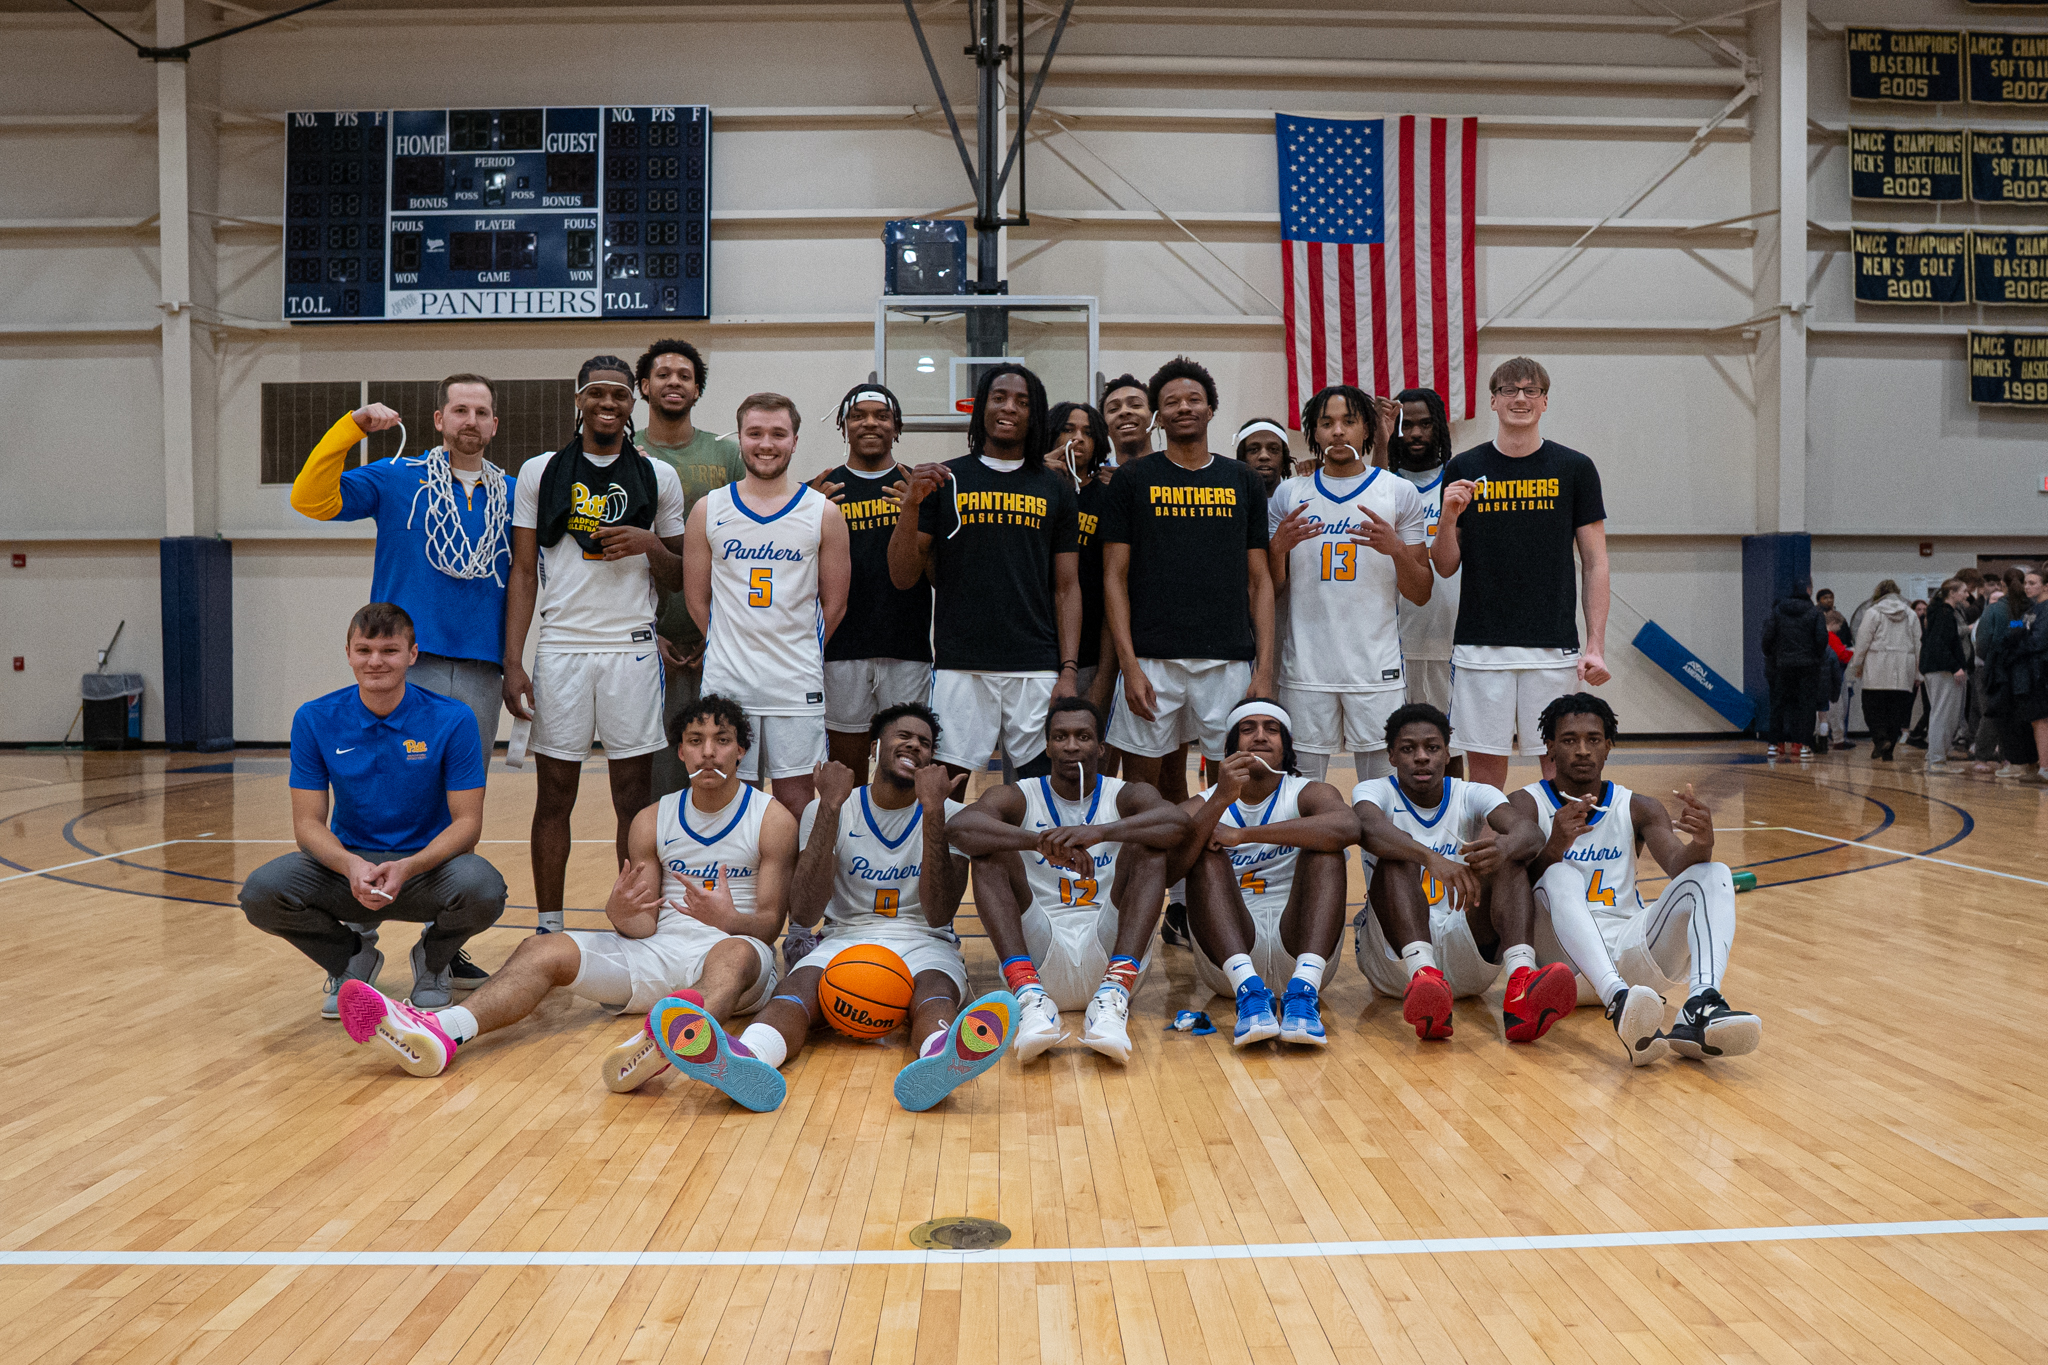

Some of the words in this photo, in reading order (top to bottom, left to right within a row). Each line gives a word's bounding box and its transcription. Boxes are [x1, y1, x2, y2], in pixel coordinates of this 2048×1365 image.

[1850, 33, 1882, 51] AMCC
[1890, 34, 1958, 54] CHAMPIONS
[1971, 36, 2004, 56] AMCC
[2012, 38, 2048, 57] CHAM
[1870, 55, 1940, 75] BASEBALL
[1880, 77, 1929, 97] 2005
[2002, 80, 2048, 100] 2007
[295, 112, 318, 127] NO.
[334, 112, 358, 127] PTS
[375, 112, 383, 126] F
[612, 108, 635, 122] NO.
[651, 107, 676, 122] PTS
[692, 108, 701, 121] F
[395, 135, 446, 155] HOME
[546, 133, 597, 153] GUEST
[1853, 132, 1886, 152] AMCC
[1893, 134, 1962, 153] CHAMPIONS
[1973, 135, 2005, 154] AMCC
[2012, 137, 2048, 156] CHAM
[475, 157, 515, 168] PERIOD
[1853, 153, 1884, 173] MEN'S
[1894, 156, 1960, 175] BASKETBALL
[455, 192, 479, 200] POSS
[511, 190, 535, 199] POSS
[1883, 176, 1932, 196] 2003
[409, 198, 449, 209] BONUS
[542, 196, 581, 207] BONUS
[391, 220, 424, 232] FOULS
[474, 219, 516, 231] PLAYER
[563, 218, 597, 229] FOULS
[1855, 234, 1887, 254] AMCC
[1896, 236, 1963, 255] CHAMPIONS
[1975, 236, 2007, 256] AMCC
[478, 271, 511, 282] GAME
[570, 270, 593, 281] WON
[1862, 256, 1904, 276] MEN'S
[1920, 258, 1955, 277] GOLF
[394, 272, 418, 283] WON
[1887, 279, 1932, 298] 2001
[2004, 280, 2048, 299] 2002
[288, 296, 331, 314] T.O.L.
[419, 291, 596, 315] PANTHERS
[605, 292, 648, 309] T.O.L.
[1973, 336, 2005, 356] AMCC
[2003, 381, 2048, 401] 1998
[1149, 485, 1237, 506] PANTHERS
[1474, 478, 1559, 500] PANTHERS
[957, 491, 1047, 517] PANTHERS
[1155, 506, 1233, 518] BASKETBALL
[1477, 500, 1555, 513] BASKETBALL
[962, 512, 1041, 529] BASKETBALL
[721, 539, 804, 561] Panthers
[1320, 541, 1358, 581] 13
[748, 567, 773, 608] 5
[1058, 877, 1100, 907] 12
[1586, 868, 1617, 907] 4
[834, 996, 895, 1028] Wilson
